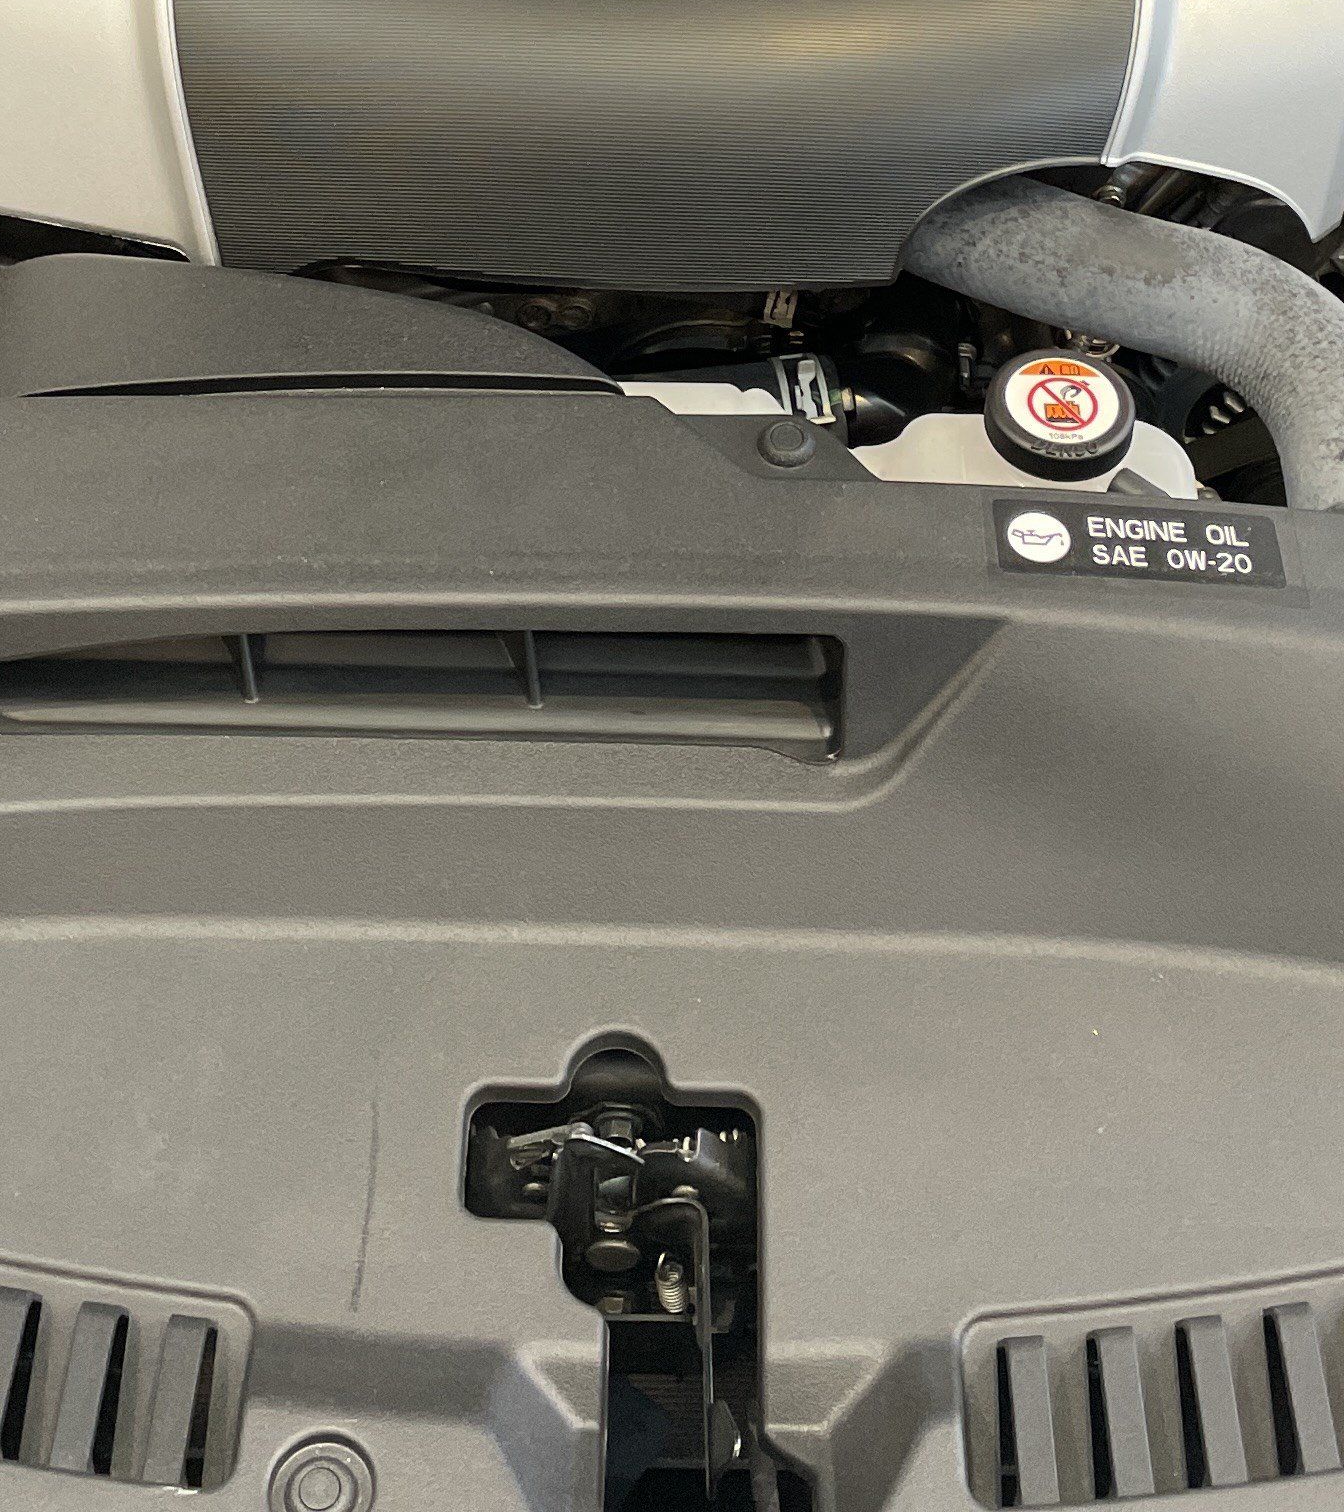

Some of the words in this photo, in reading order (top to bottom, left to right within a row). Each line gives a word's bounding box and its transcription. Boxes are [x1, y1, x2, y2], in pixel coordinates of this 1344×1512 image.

[1086, 515, 1186, 544] ENGINE
[1205, 523, 1249, 548] OIL
[1091, 544, 1148, 569] SAE
[1167, 549, 1253, 574] 0W-20
